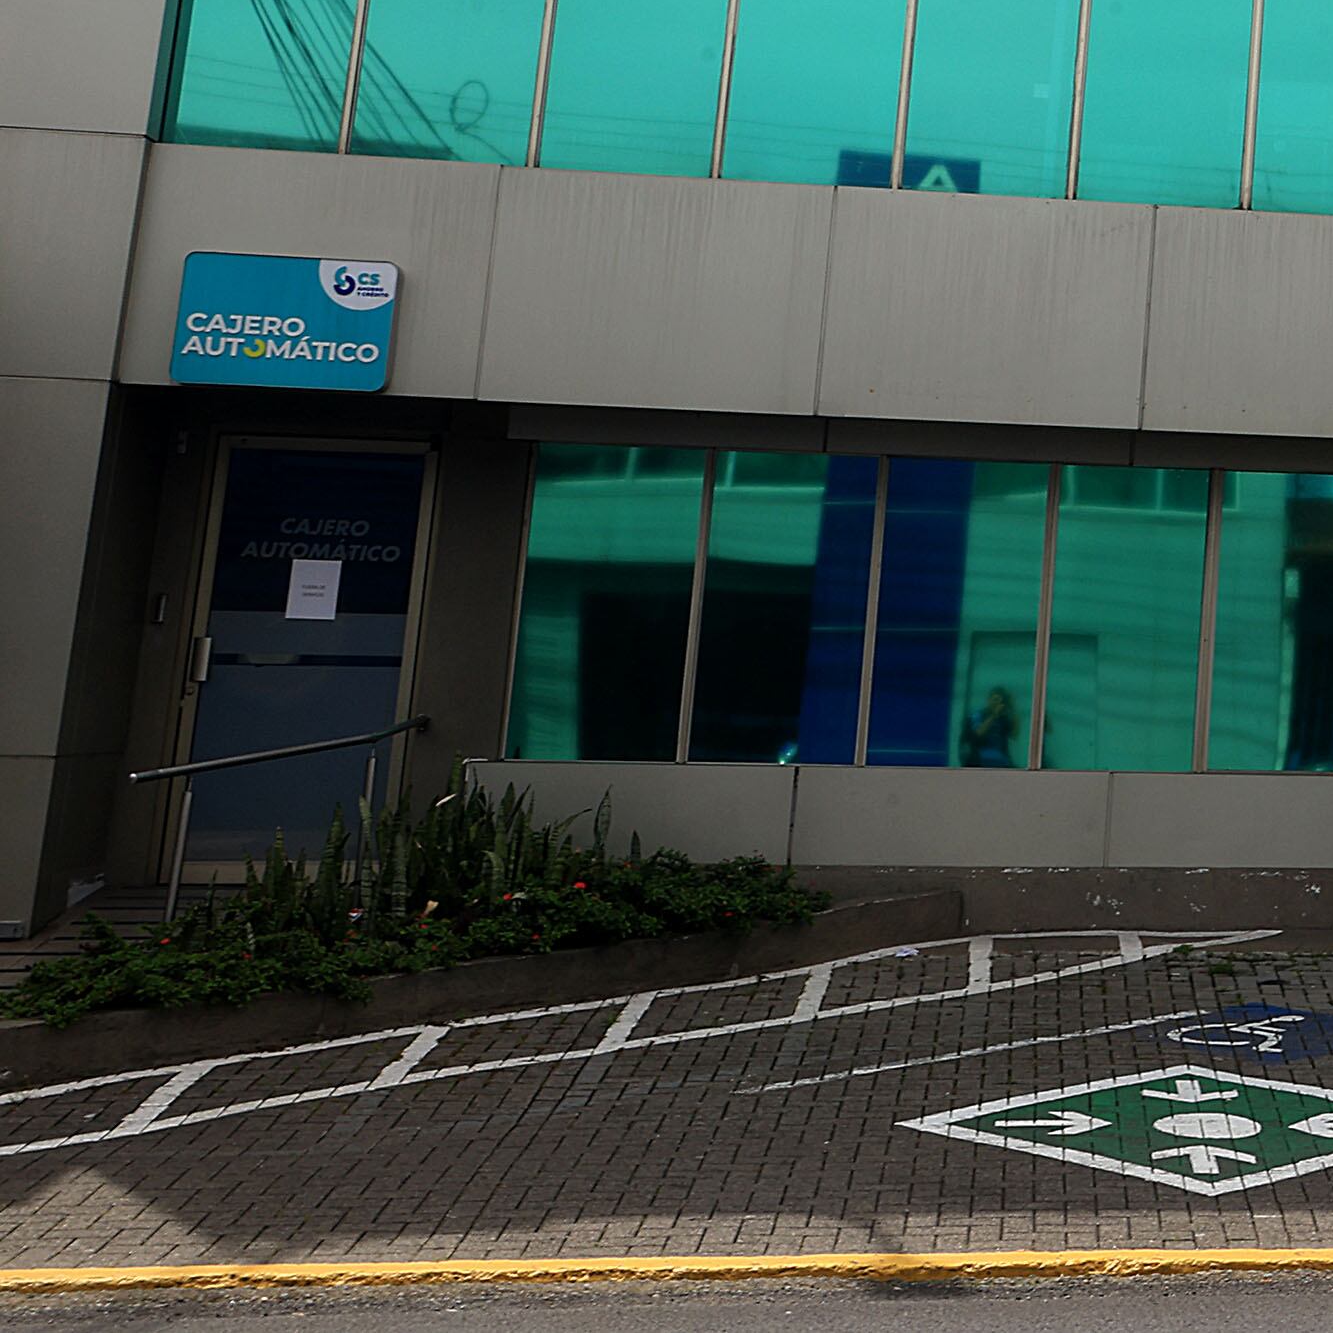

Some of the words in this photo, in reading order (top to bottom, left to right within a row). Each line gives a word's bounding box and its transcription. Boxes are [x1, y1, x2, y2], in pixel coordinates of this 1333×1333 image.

[358, 272, 380, 286] CS
[186, 312, 305, 337] CAJERO
[181, 335, 380, 363] AUTOMÁTICO
[280, 518, 370, 537] CAJERO
[240, 538, 401, 563] AUTOMÁTICO
